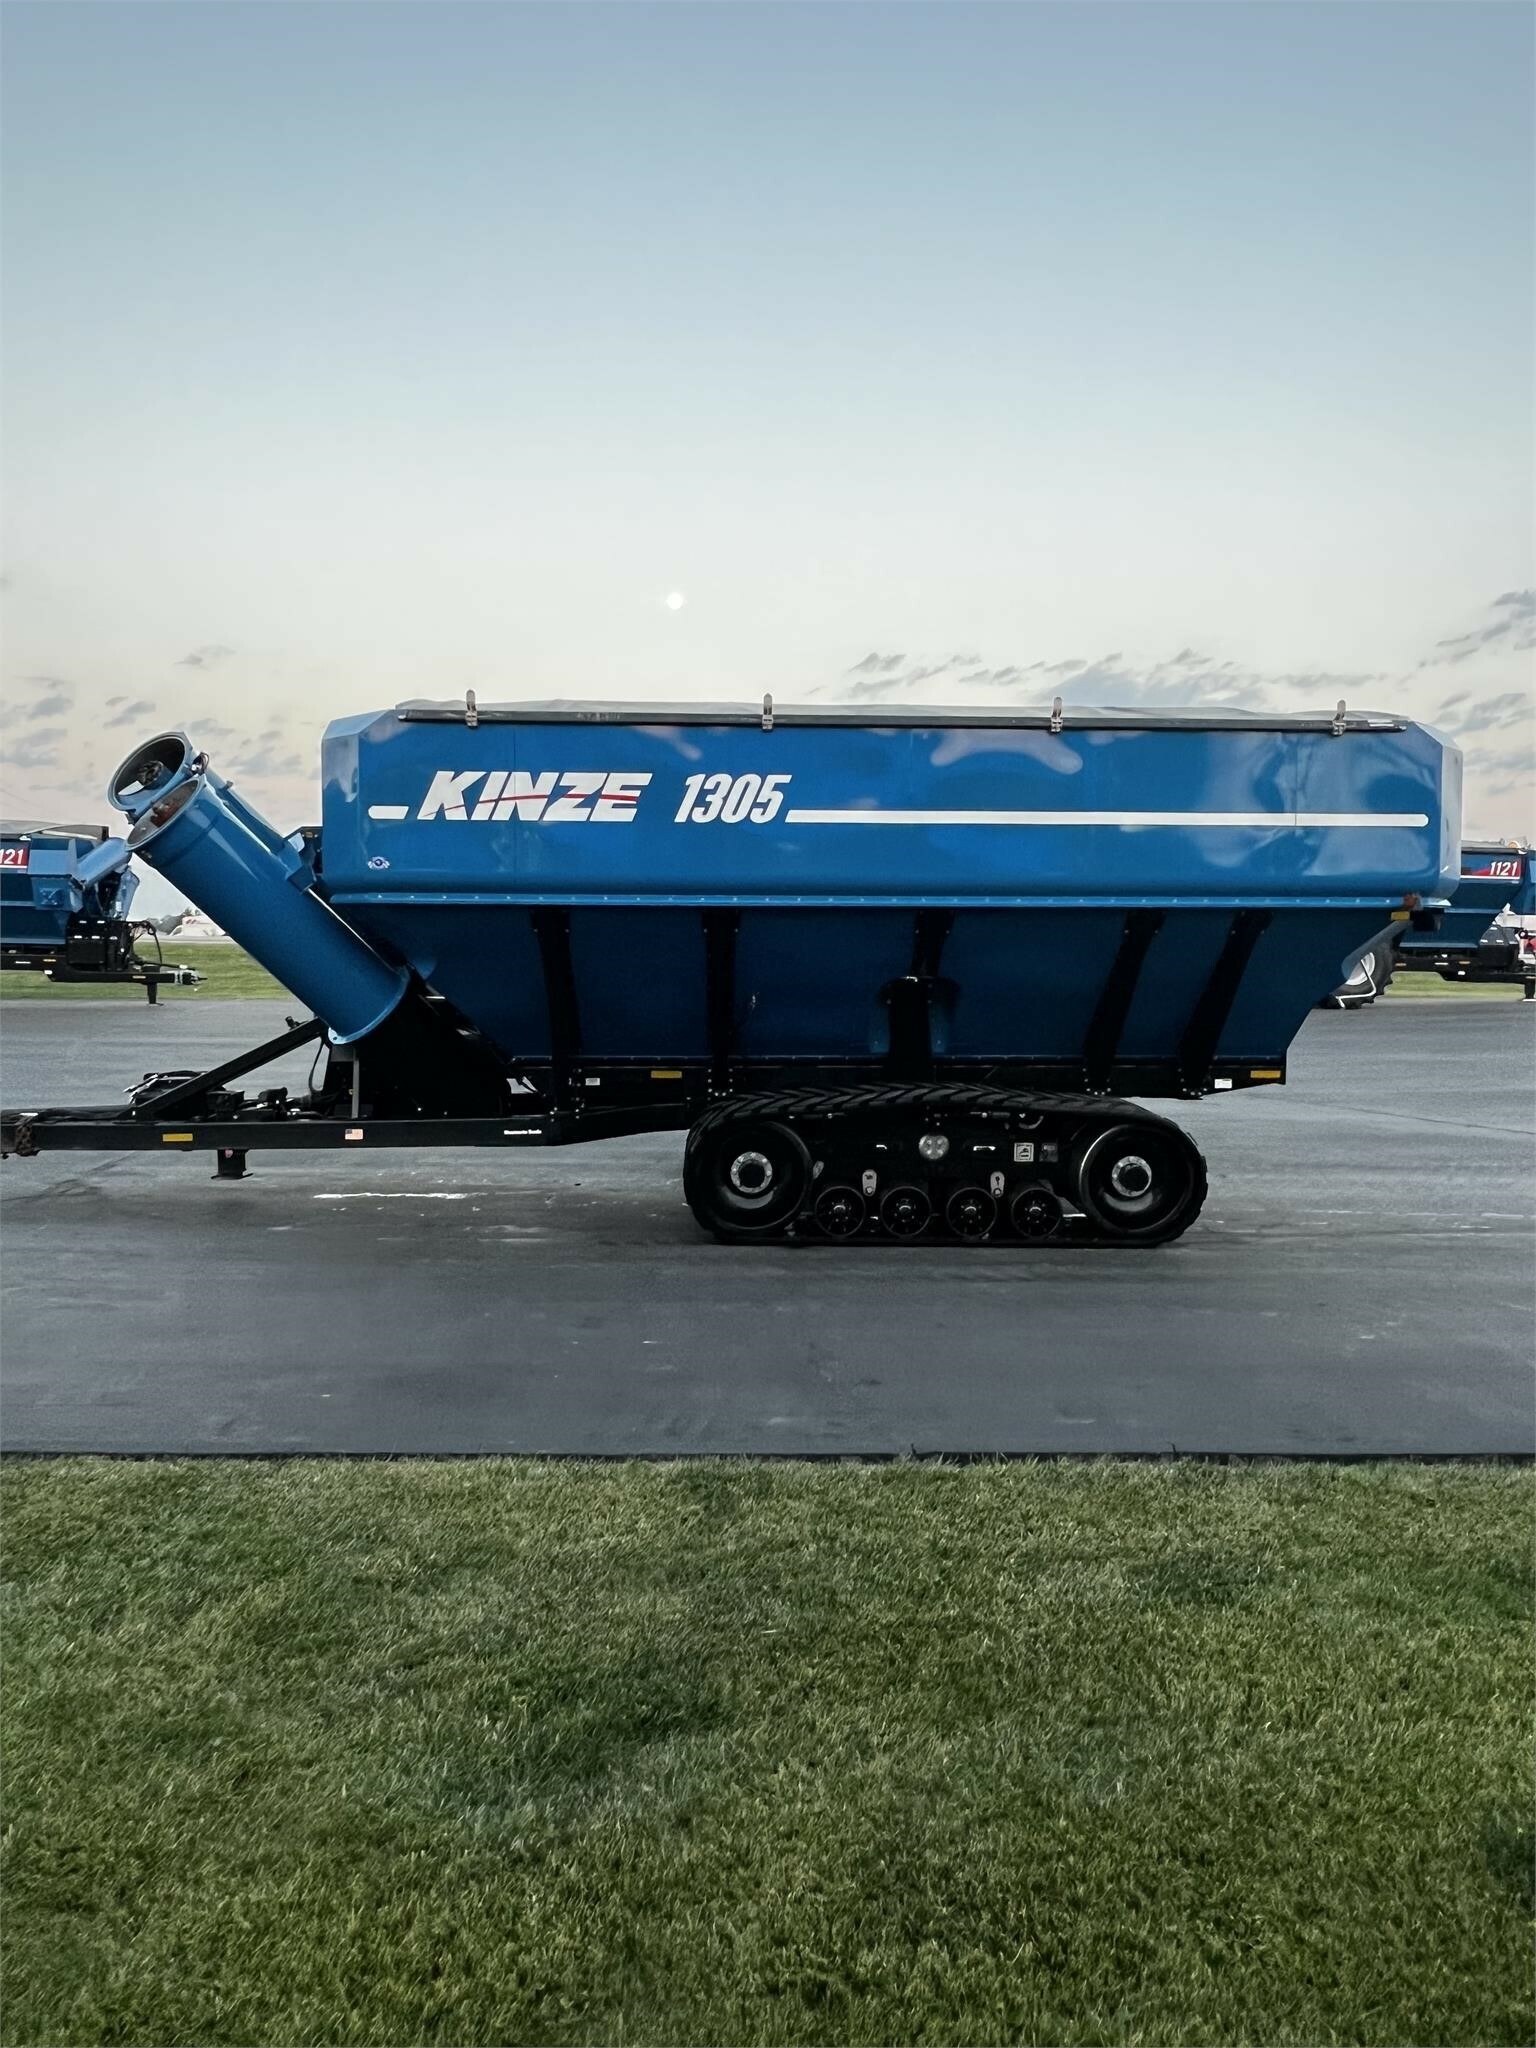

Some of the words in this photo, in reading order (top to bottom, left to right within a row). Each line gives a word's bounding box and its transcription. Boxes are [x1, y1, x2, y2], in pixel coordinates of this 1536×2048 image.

[416, 770, 654, 822] KINZE
[673, 773, 793, 824] 1305
[1489, 861, 1518, 876] 1121
